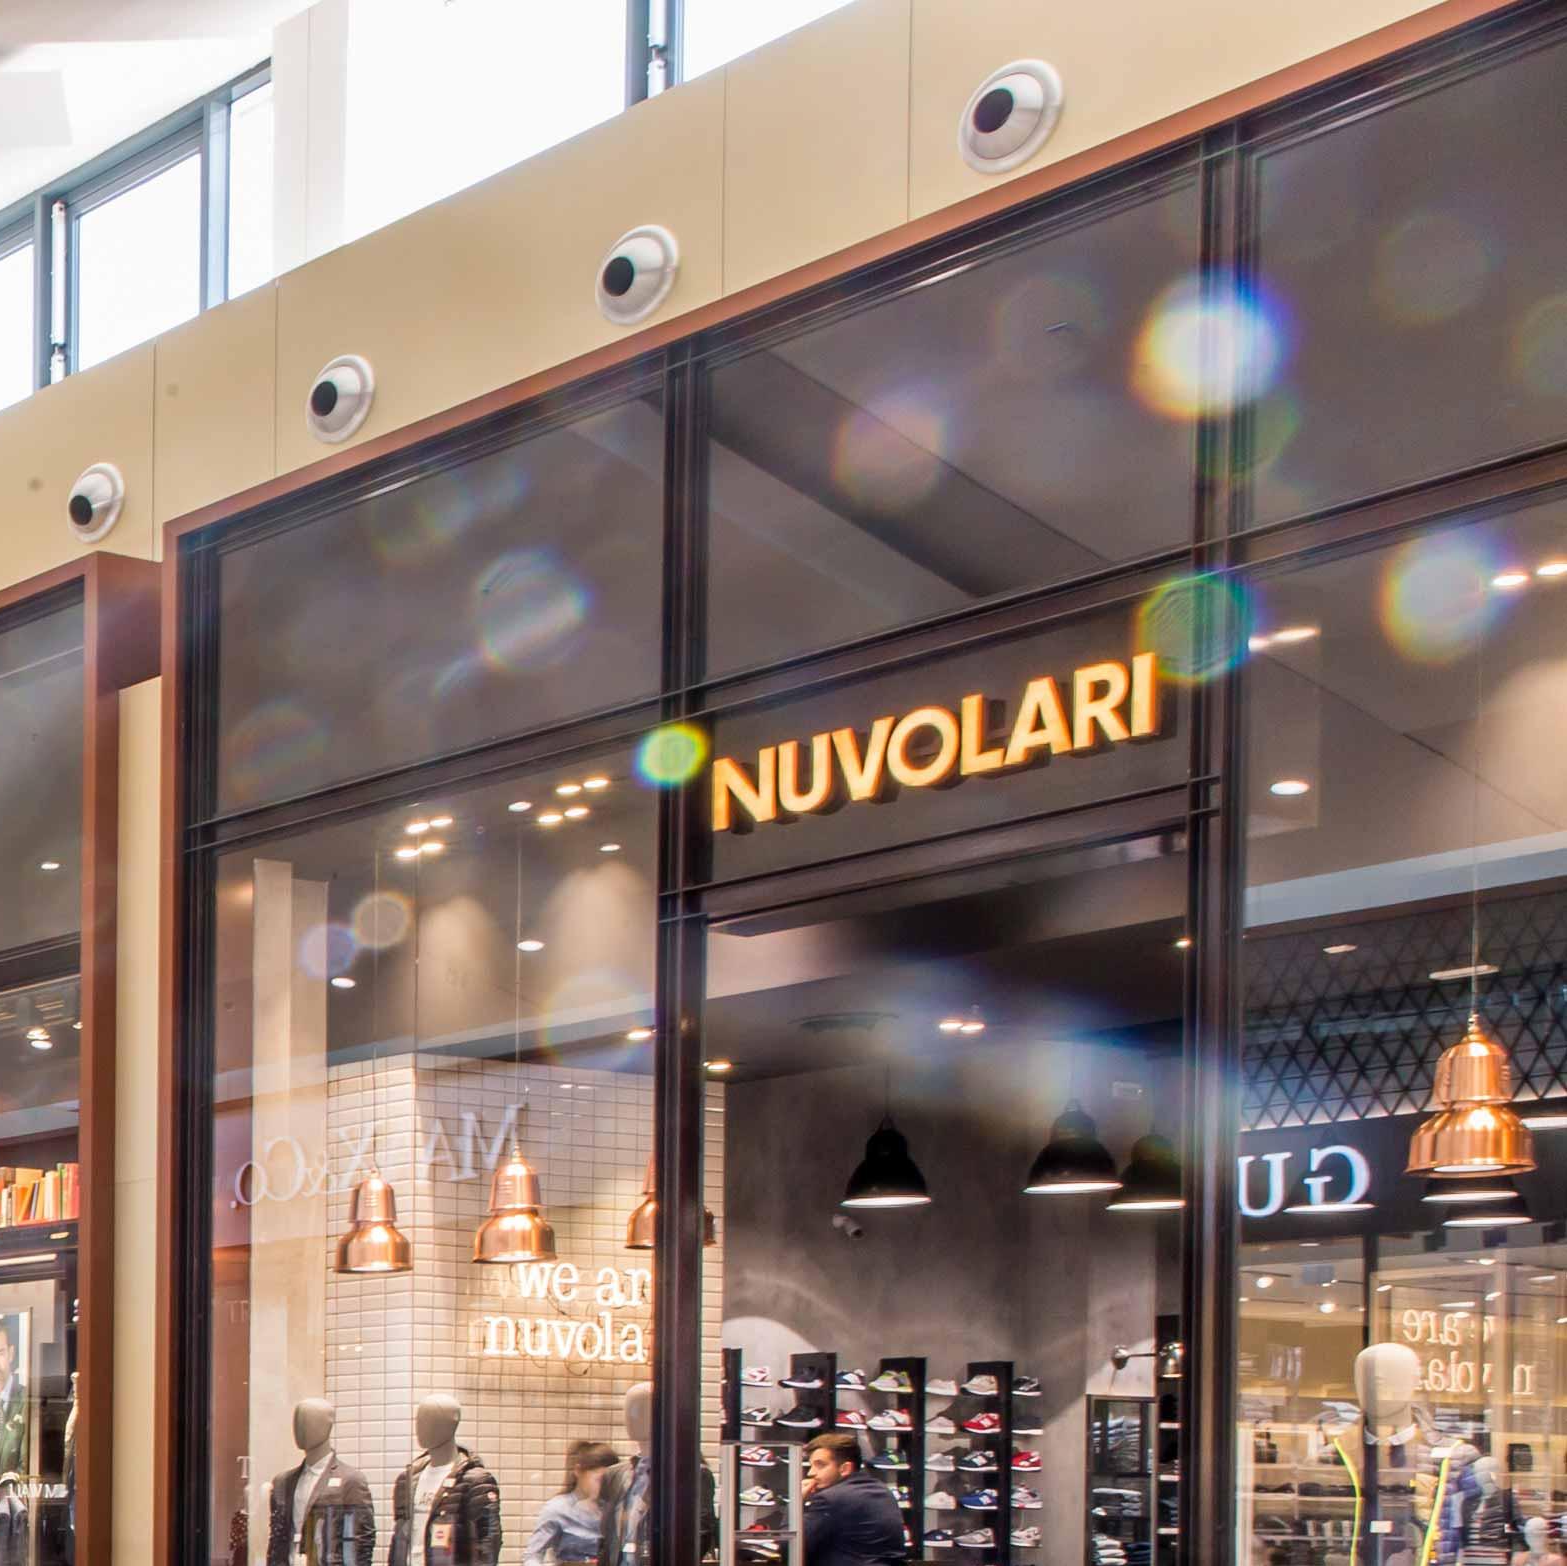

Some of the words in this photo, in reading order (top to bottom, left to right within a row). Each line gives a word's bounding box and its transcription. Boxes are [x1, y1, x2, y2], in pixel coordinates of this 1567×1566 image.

[712, 652, 1158, 833] NUVOLARI
[517, 1262, 580, 1302] we
[595, 1266, 652, 1308] ar
[483, 1311, 648, 1363] nuvola
